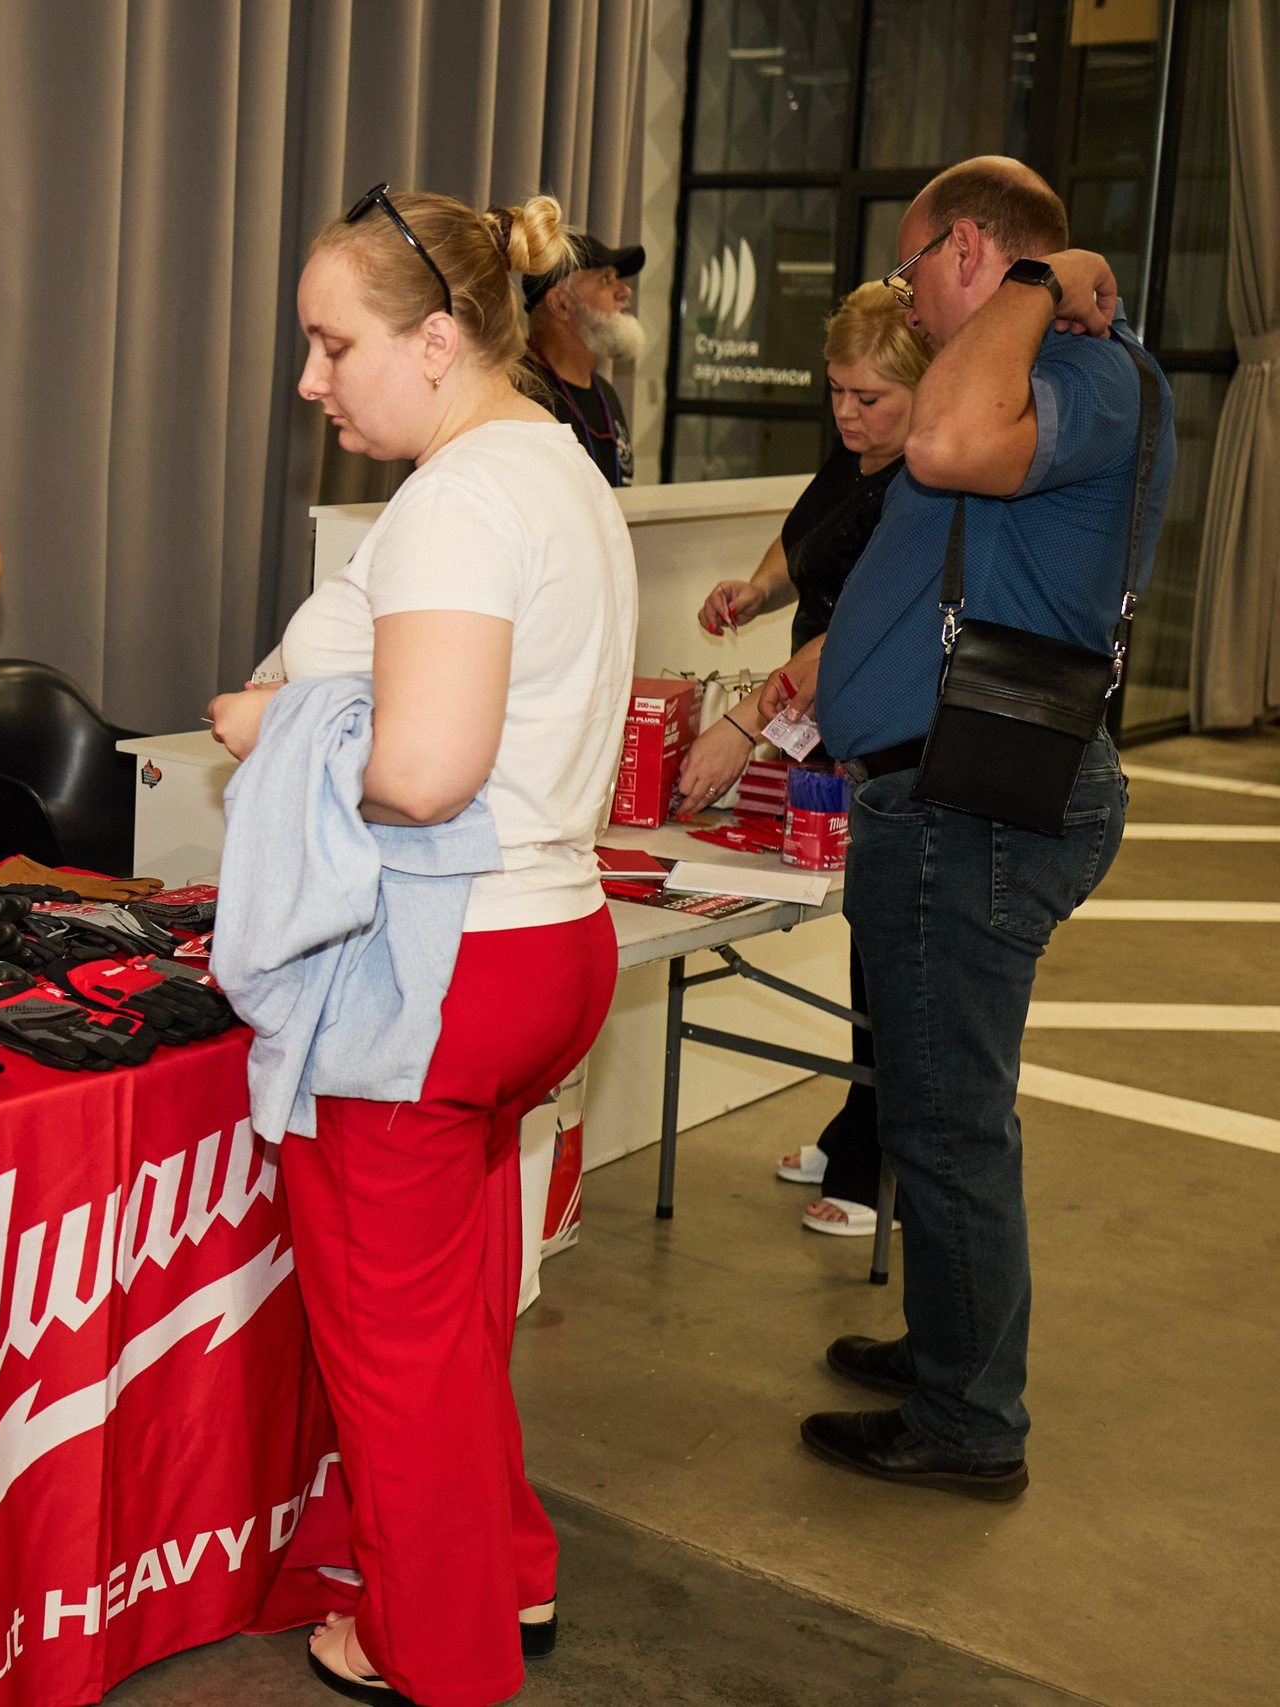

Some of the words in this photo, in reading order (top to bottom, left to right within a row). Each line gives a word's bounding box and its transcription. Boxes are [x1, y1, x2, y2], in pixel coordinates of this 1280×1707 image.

[695, 333, 759, 360] Студия
[693, 363, 811, 387] звукозаписи
[636, 716, 661, 724] PLUGS
[43, 1516, 256, 1640] HEAVY
